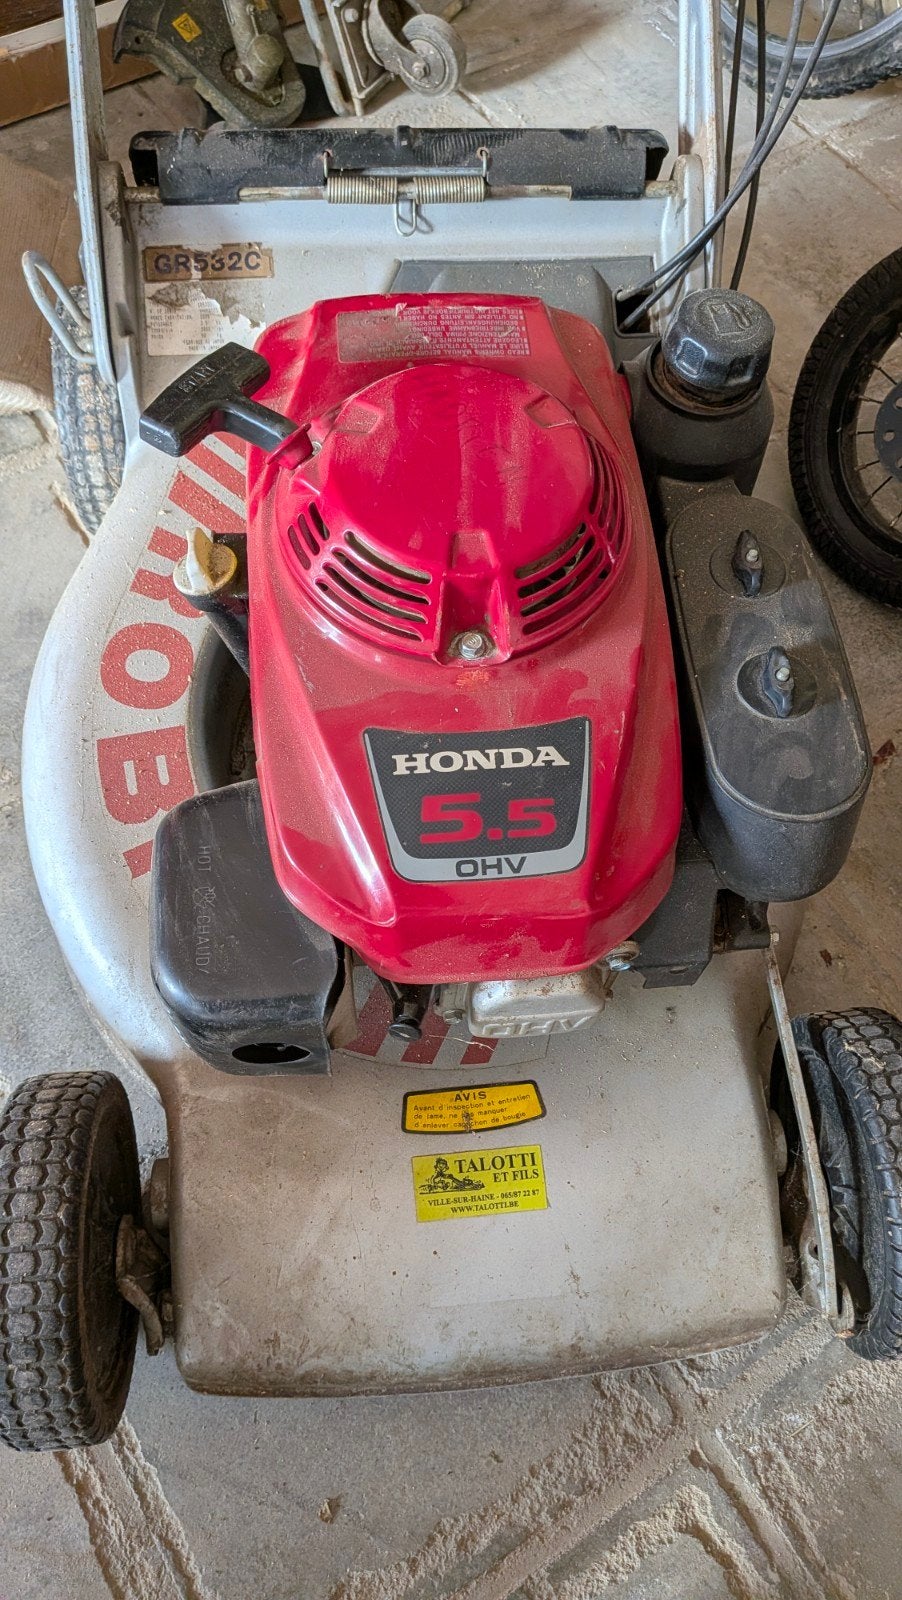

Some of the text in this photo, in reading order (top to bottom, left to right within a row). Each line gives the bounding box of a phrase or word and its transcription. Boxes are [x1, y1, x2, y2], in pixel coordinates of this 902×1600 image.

[154, 251, 261, 273] GR532C
[392, 746, 570, 775] HONDA
[421, 792, 557, 844] 5.5
[197, 846, 212, 872] HOT
[455, 856, 527, 878] OHV
[454, 1091, 487, 1102] AVIS
[498, 1095, 531, 1105] entretien
[478, 1107, 508, 1117] manquer
[503, 1112, 527, 1121] bougie
[454, 1152, 538, 1174] TALOTTI
[493, 1169, 540, 1183] ET FILS
[428, 1193, 495, 1206] VILLE-SUR-HAINE
[500, 1190, 522, 1199] 065/87
[522, 1189, 531, 1197] 22
[532, 1188, 540, 1196] 87
[450, 1200, 520, 1214] WWW.TALOTTI.BE
